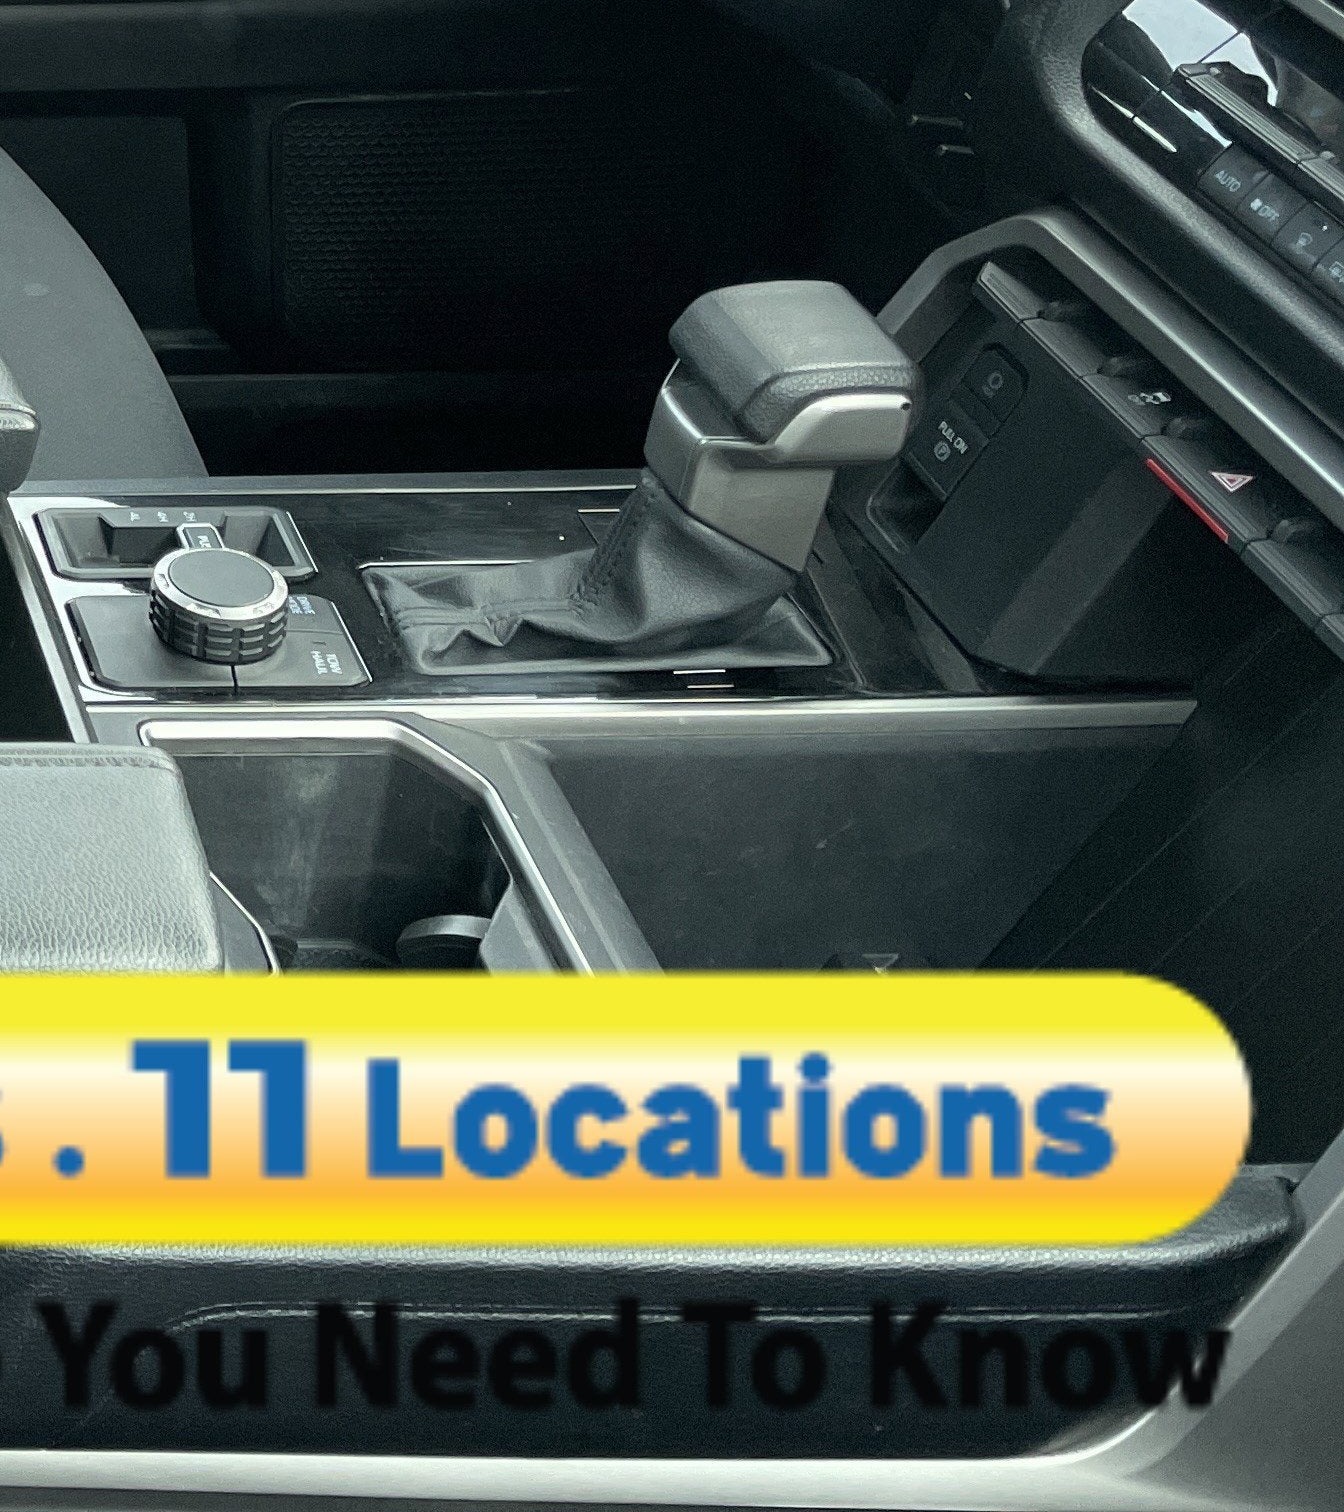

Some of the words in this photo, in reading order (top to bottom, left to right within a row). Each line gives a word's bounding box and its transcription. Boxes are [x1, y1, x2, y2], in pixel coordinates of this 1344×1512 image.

[1215, 170, 1242, 193] AUTO
[937, 420, 956, 443] PULL
[953, 436, 969, 455] ON
[310, 650, 328, 675] HAUL
[325, 653, 343, 675] TOW
